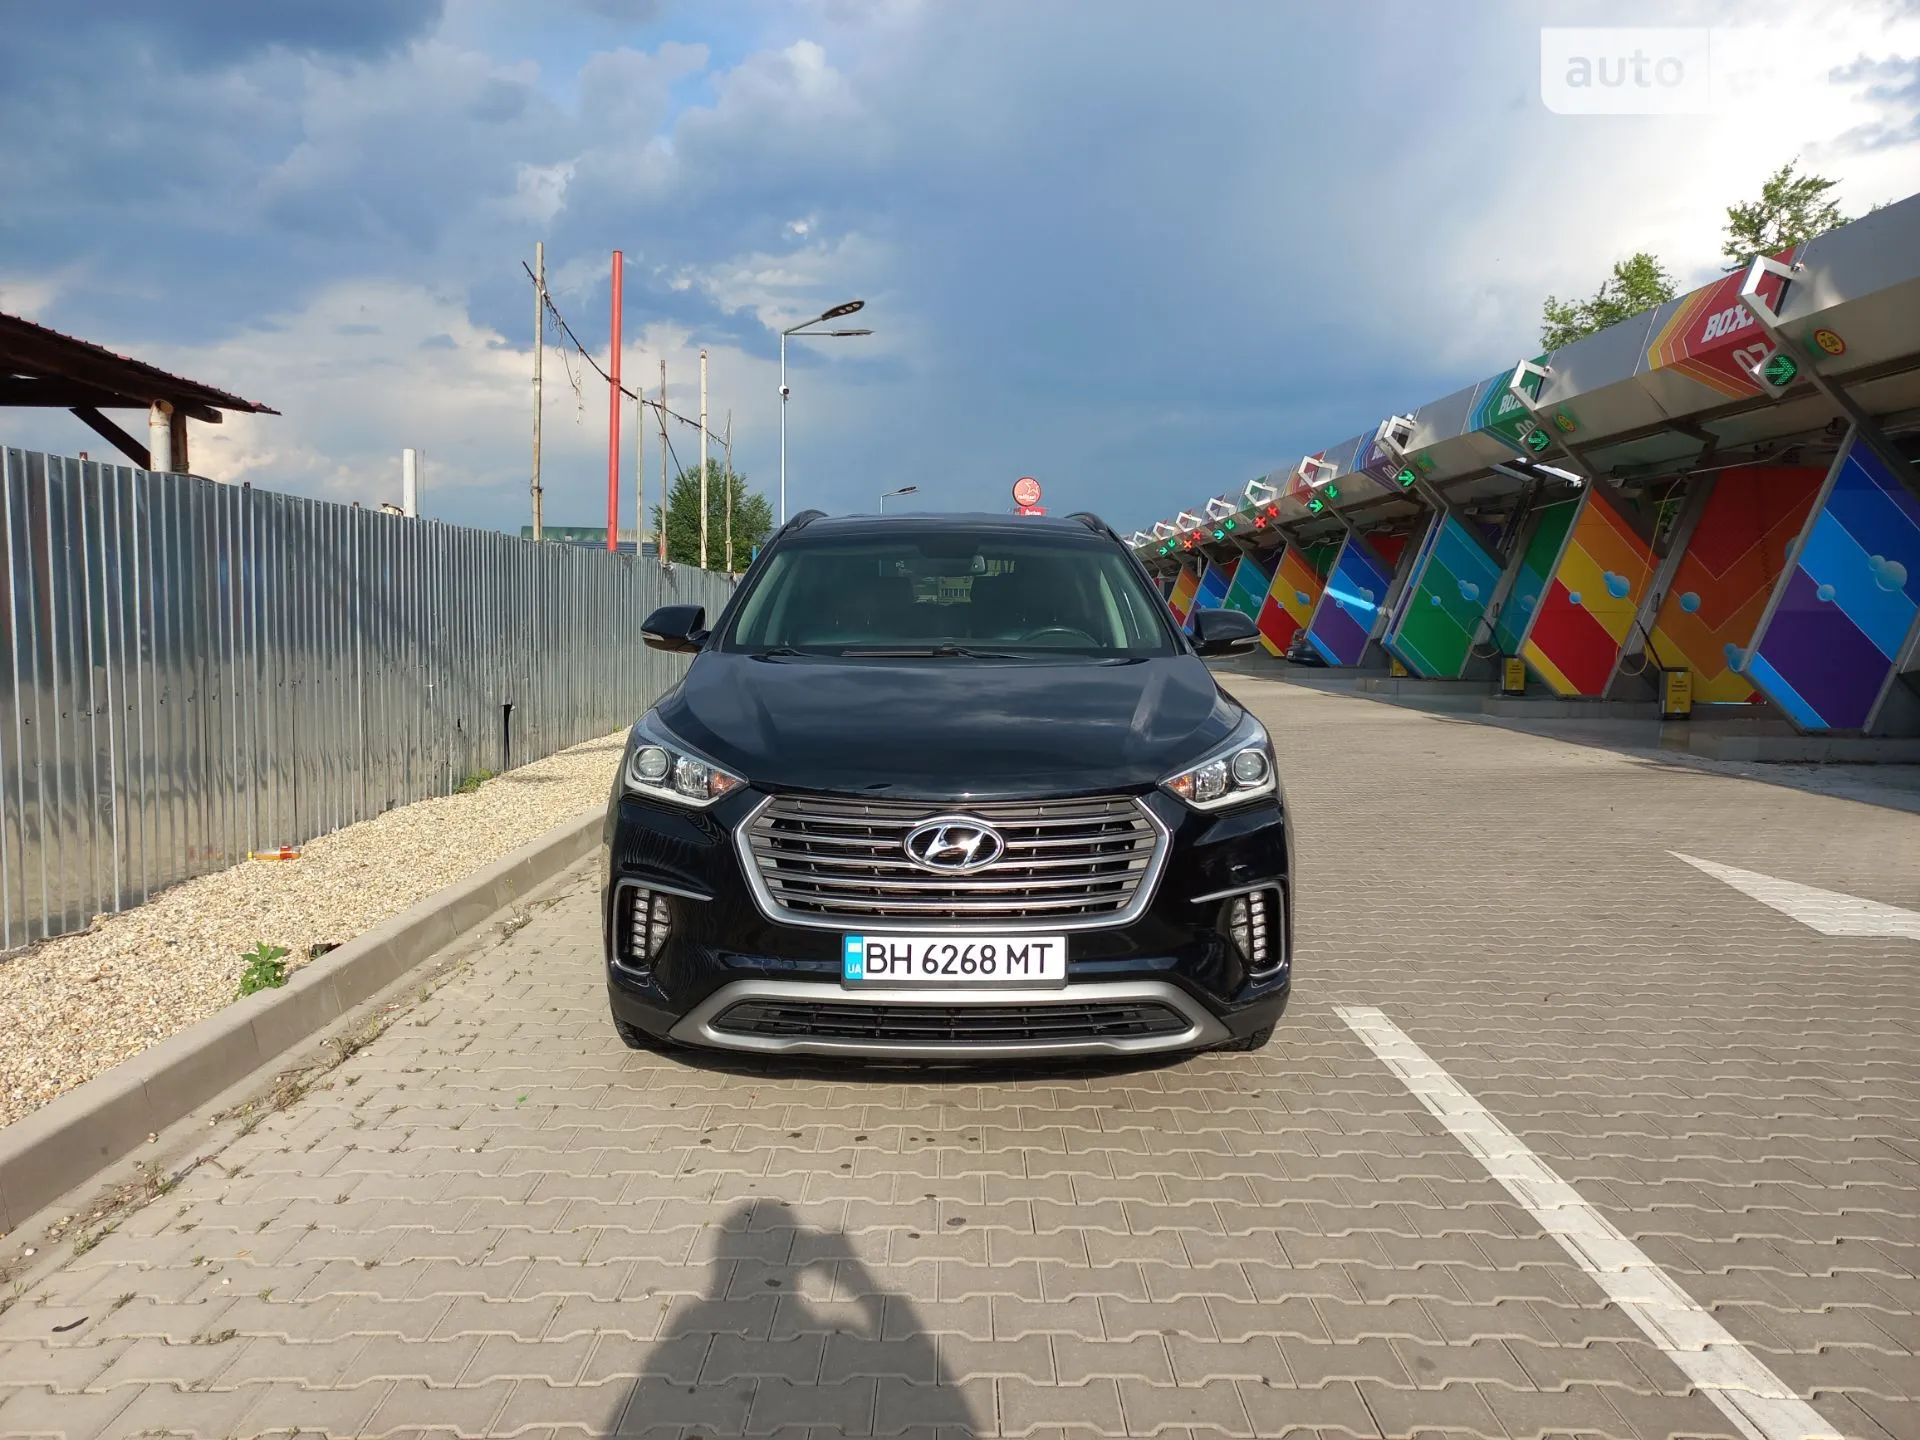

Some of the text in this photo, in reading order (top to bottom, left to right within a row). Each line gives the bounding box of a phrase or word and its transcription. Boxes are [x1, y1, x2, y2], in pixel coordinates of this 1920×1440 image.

[848, 964, 862, 974] UA
[865, 943, 1053, 975] BH 6268 MT
